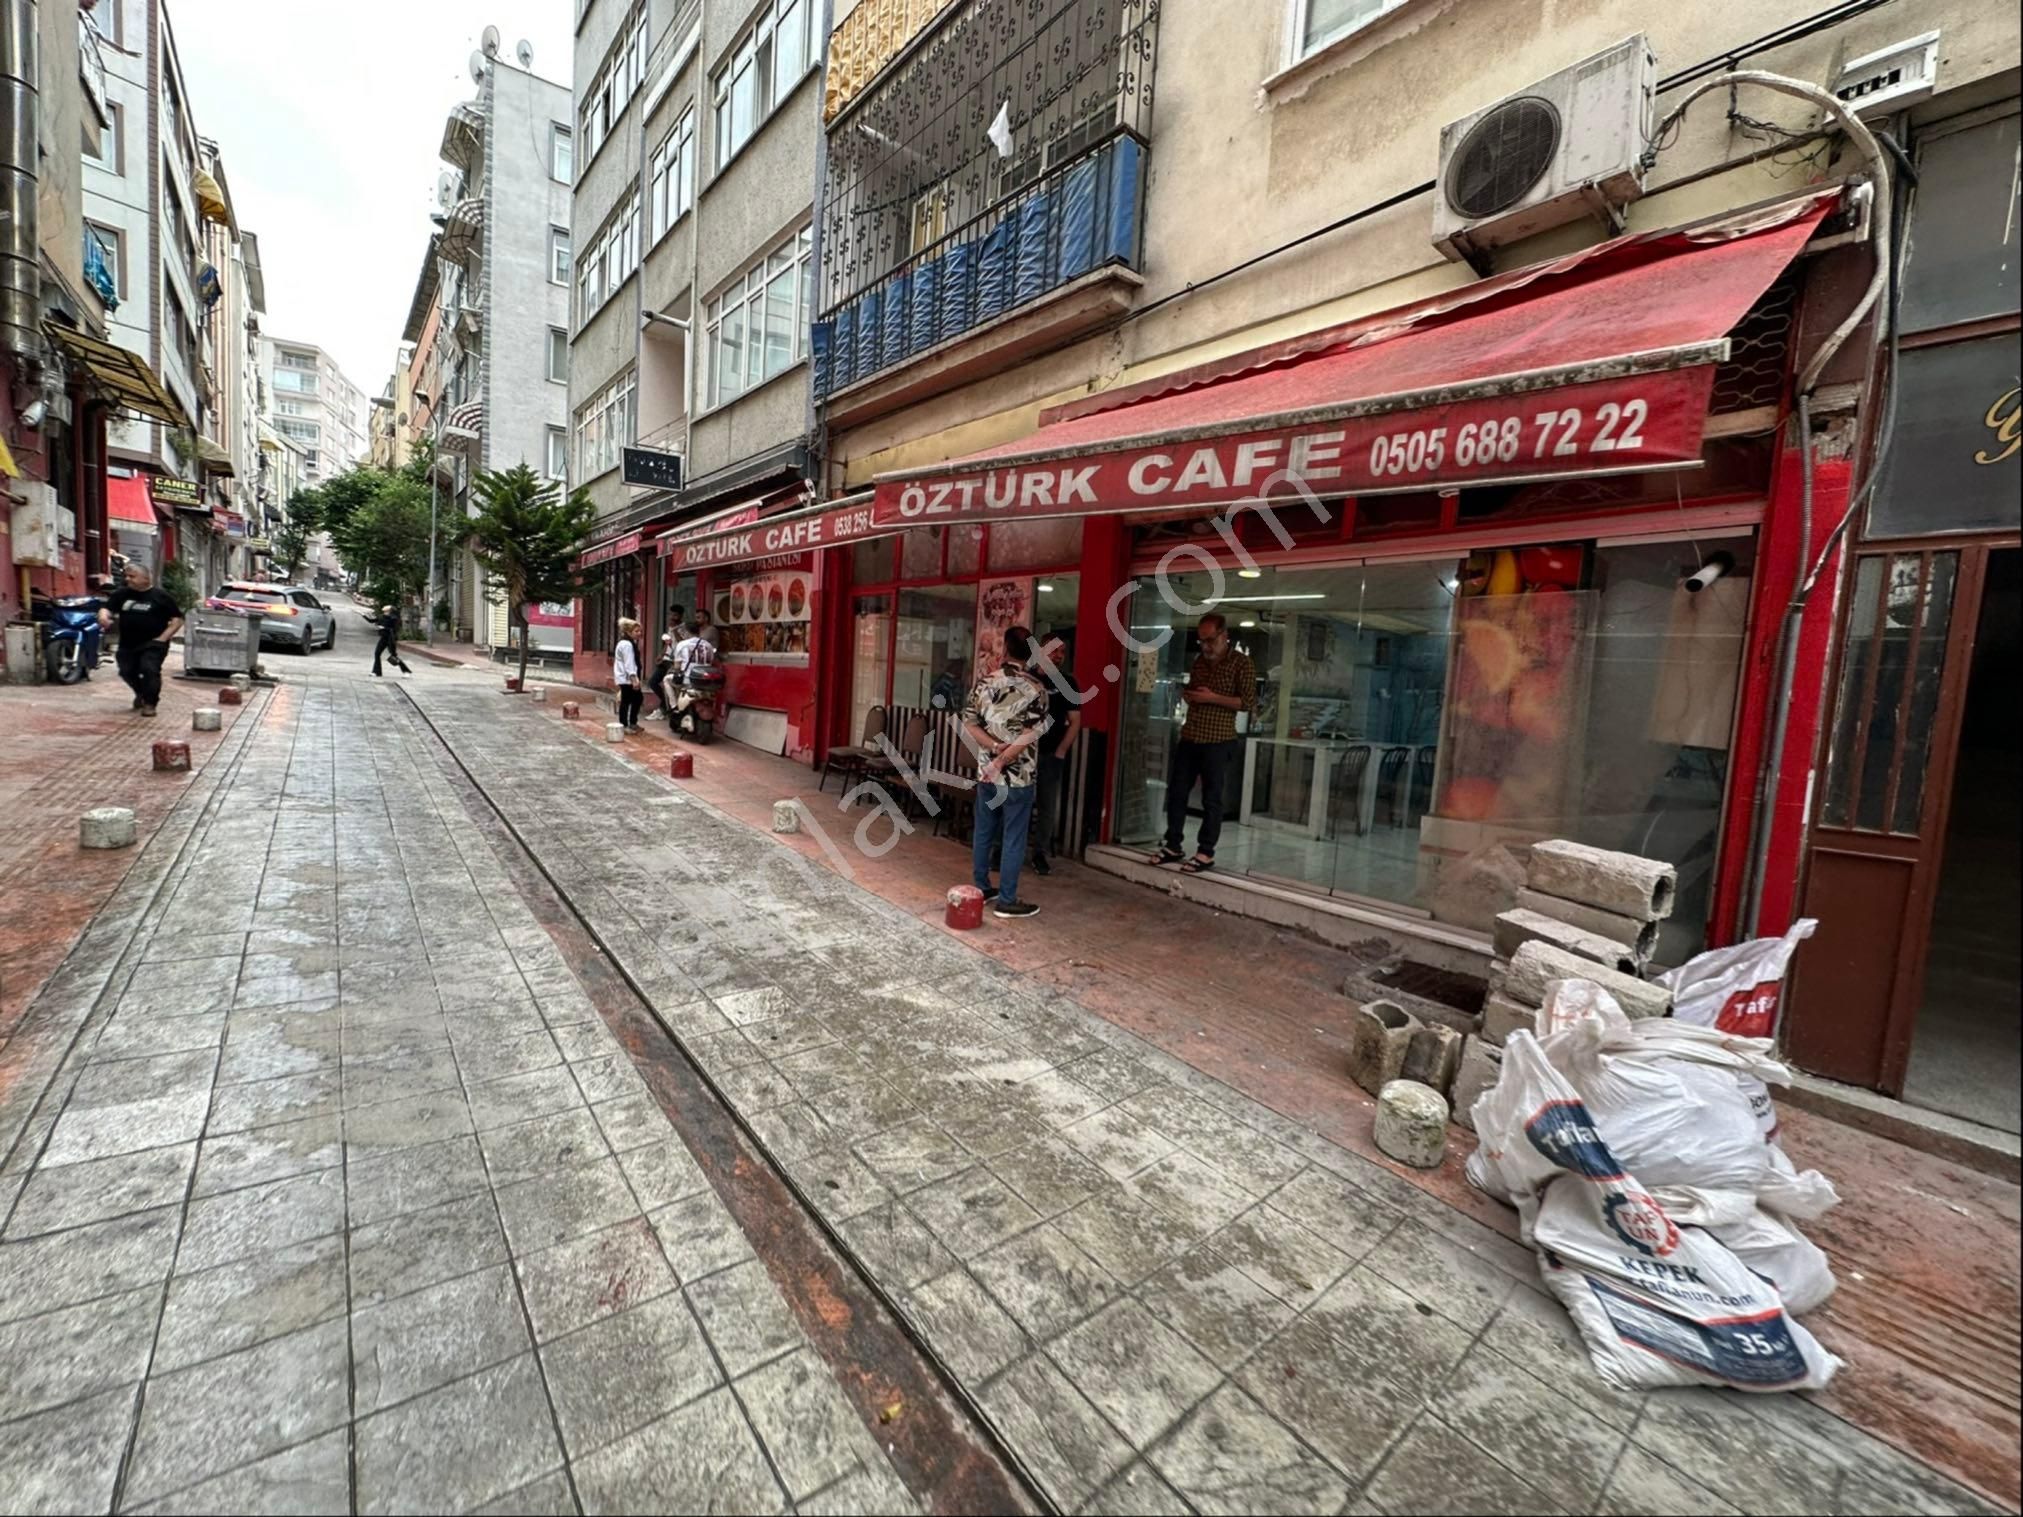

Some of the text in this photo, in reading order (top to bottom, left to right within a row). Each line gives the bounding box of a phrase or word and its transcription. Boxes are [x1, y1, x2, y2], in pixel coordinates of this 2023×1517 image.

[899, 398, 1648, 518] ÖZTÜRK CAFE 0505 688 72 22
[765, 518, 822, 550] CAFE
[1627, 1225, 1660, 1241] UN
[1618, 1256, 1708, 1287] KEPEK
[1732, 1331, 1775, 1356] 35
